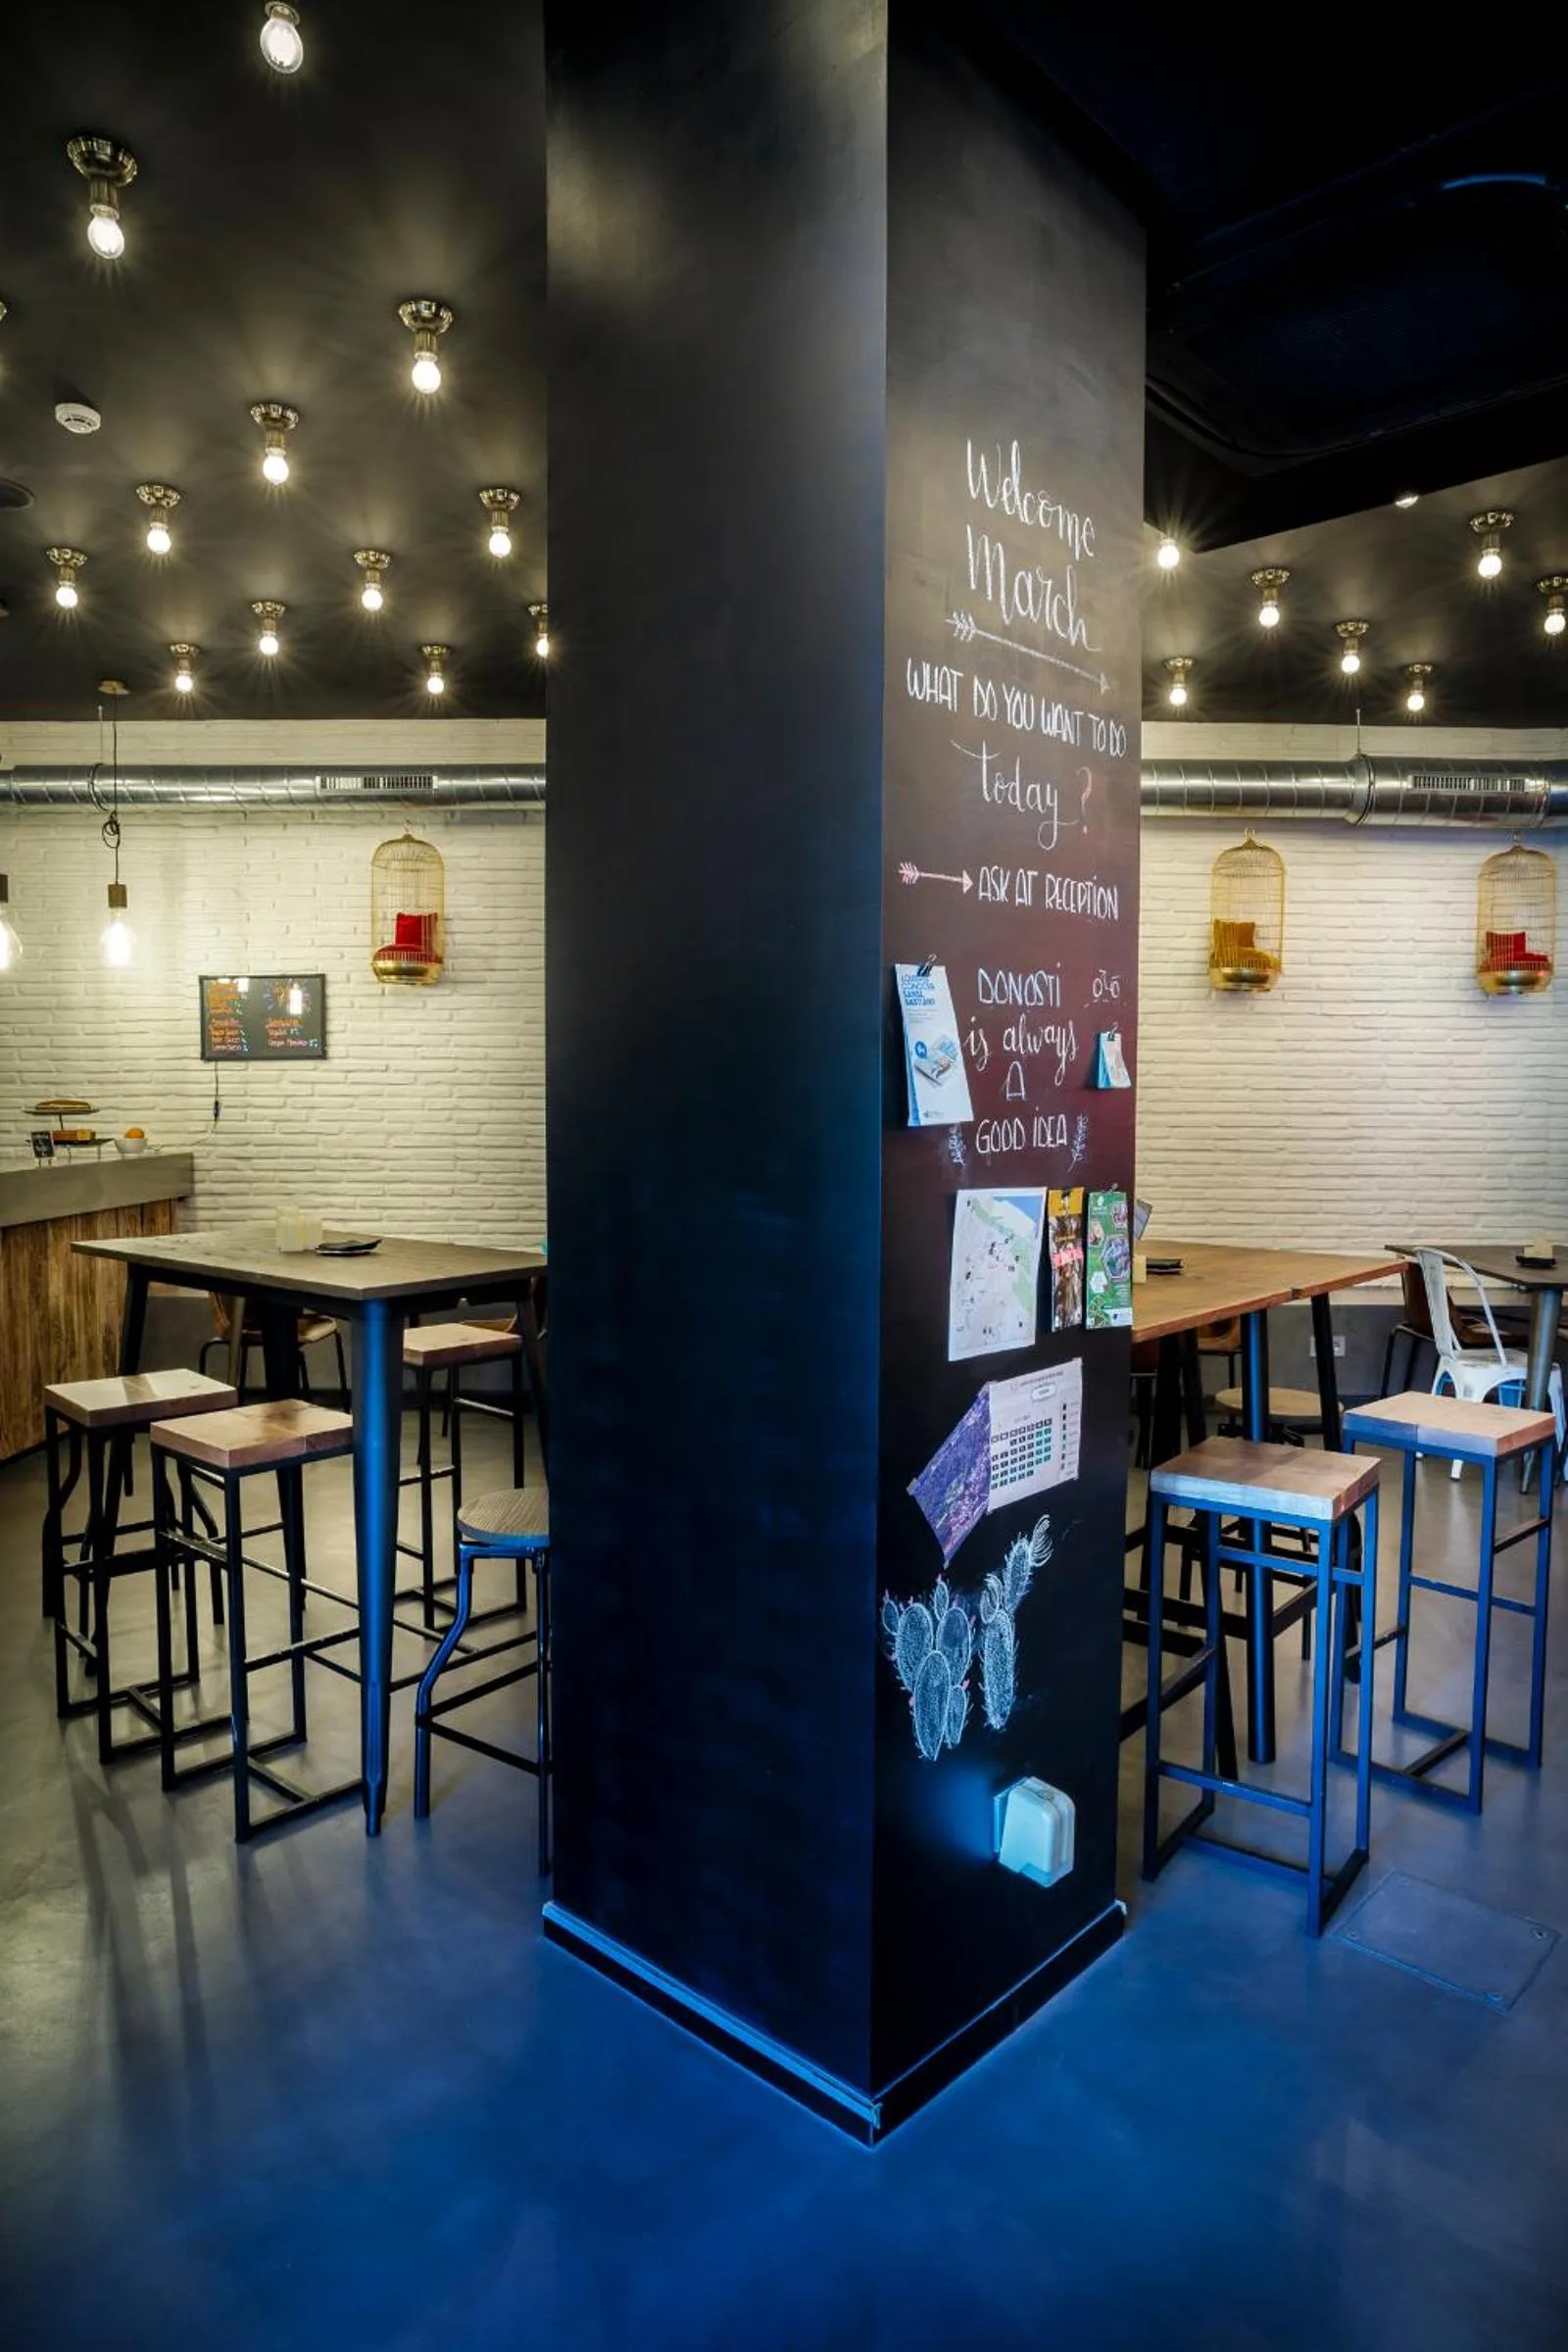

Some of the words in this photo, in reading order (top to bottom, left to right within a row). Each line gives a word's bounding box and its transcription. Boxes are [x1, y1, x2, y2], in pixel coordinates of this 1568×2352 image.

[967, 439, 1096, 561] Welcome
[966, 523, 1102, 653] March
[906, 658, 963, 712] WHAT
[973, 675, 998, 721] DO
[1002, 683, 1035, 731] YOU
[1041, 698, 1084, 746] WANT
[1089, 712, 1107, 753] TO
[1109, 724, 1127, 759] DO
[978, 865, 1010, 903] ASK
[1015, 868, 1038, 906] AT
[963, 1015, 990, 1072] is
[1003, 1013, 1078, 1086] always
[1006, 1061, 1026, 1101] A
[976, 1117, 1026, 1153] GOOD
